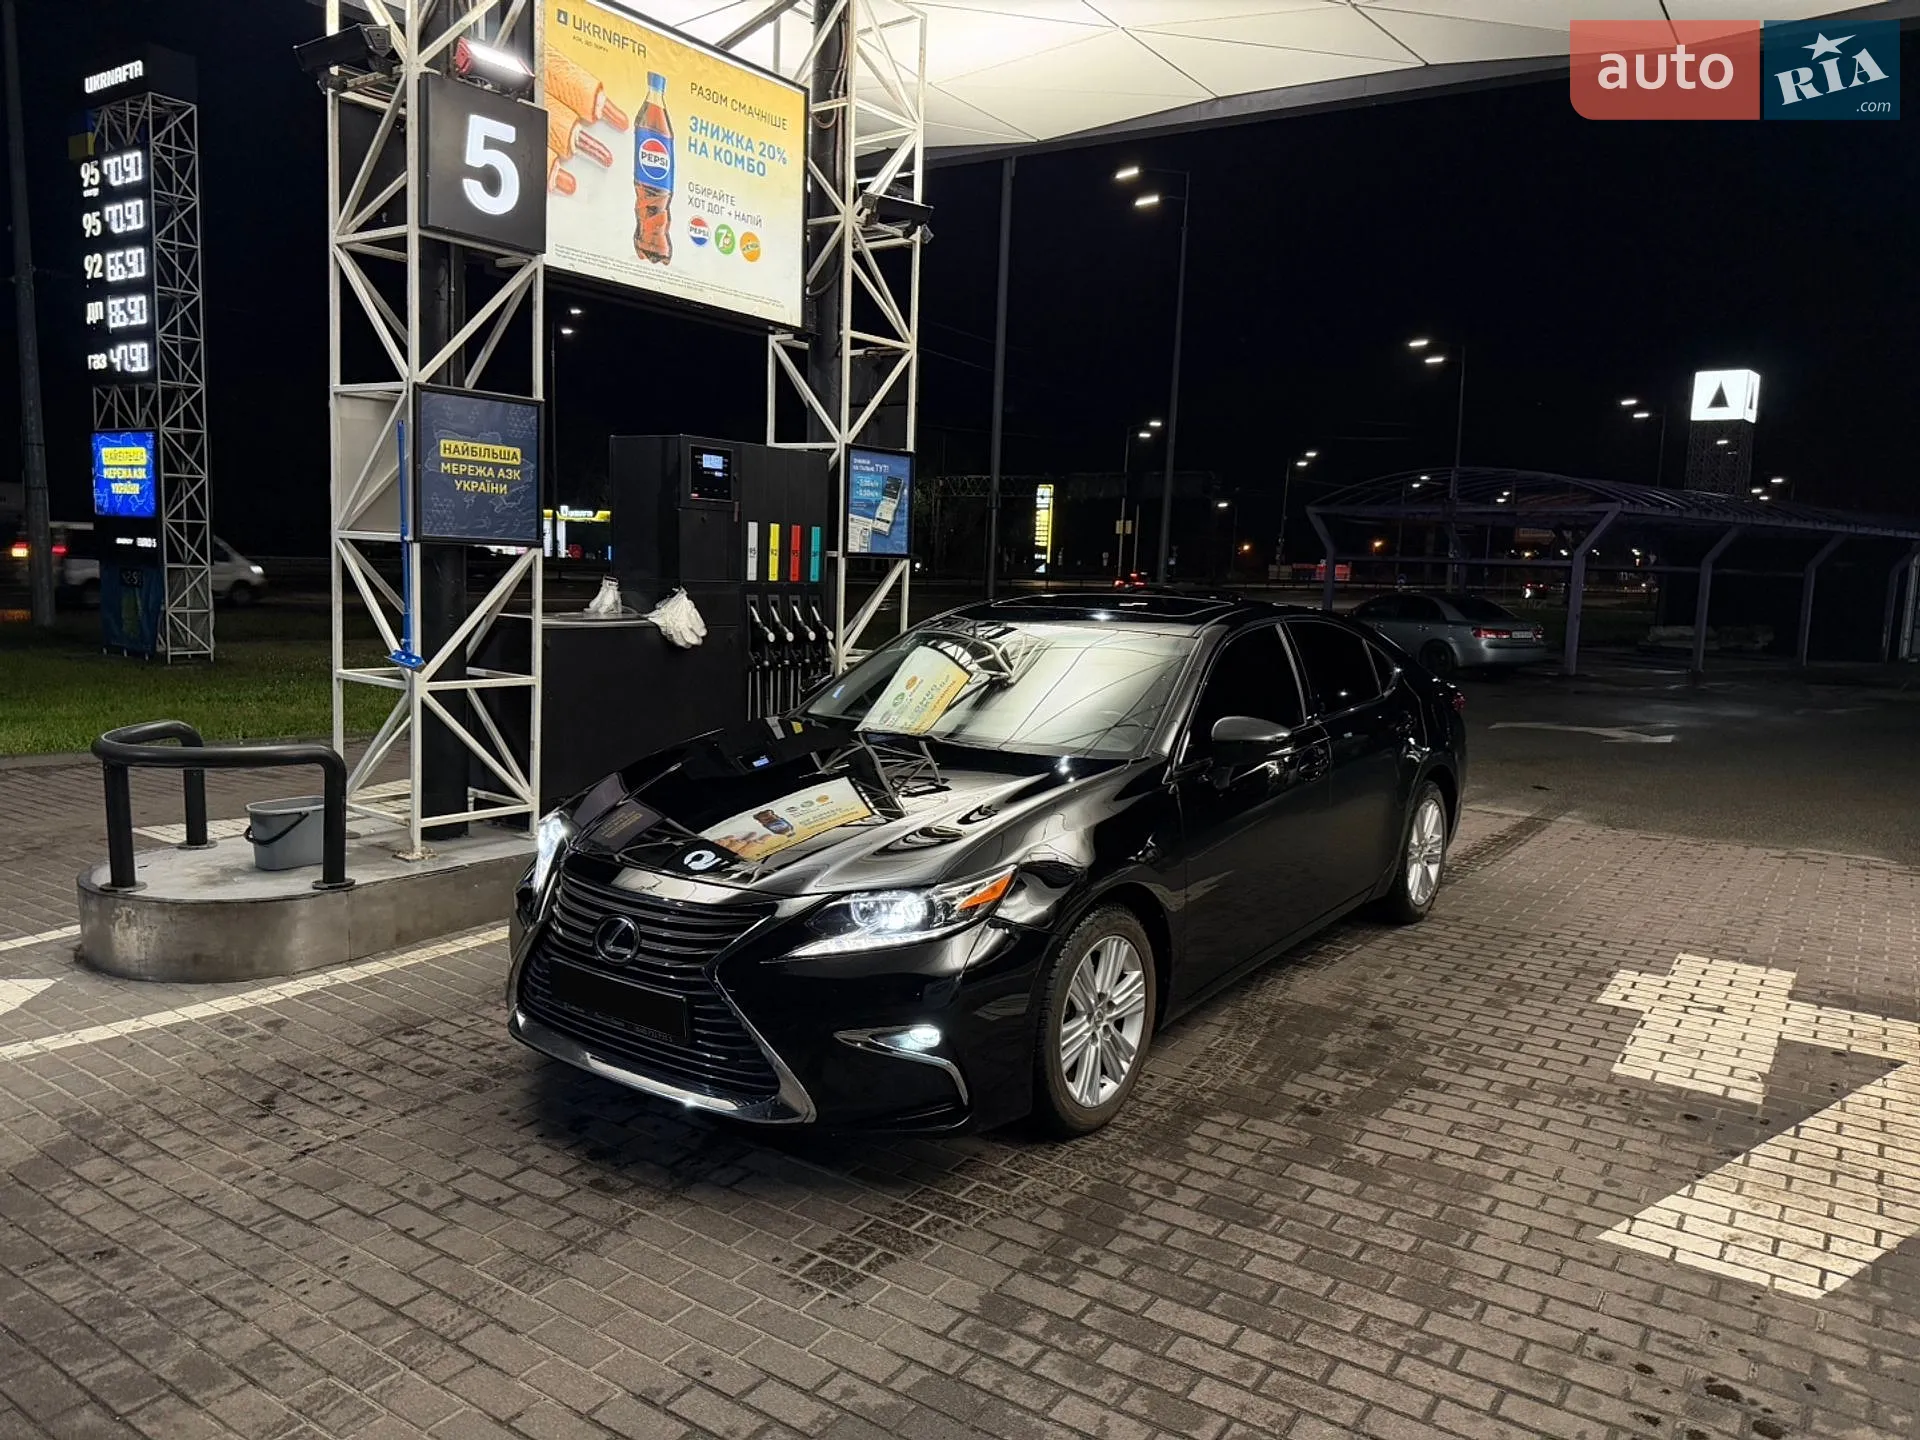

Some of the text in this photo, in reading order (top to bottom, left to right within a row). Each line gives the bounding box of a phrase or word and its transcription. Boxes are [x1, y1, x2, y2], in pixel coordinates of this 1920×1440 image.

[572, 14, 648, 59] UKRNAFTA
[84, 59, 144, 94] UKRNAFTA
[690, 82, 788, 131] РАЗОМ СМАЧНІШЕ
[689, 115, 788, 166] ЗНИЖКА 20%
[462, 114, 520, 215] 5
[641, 151, 668, 168] PEPSI
[687, 136, 767, 177] НА КОМБО
[81, 160, 100, 188] 95
[687, 181, 736, 207] ОБИРАЙТЕ
[687, 194, 705, 211] ХОТ
[82, 211, 102, 238] 95
[84, 253, 103, 280] 92
[442, 442, 520, 462] НАЙБІЛЬША
[441, 462, 520, 480] МЕРЕЖА АЗК
[454, 479, 508, 495] УКРАЇНИ
